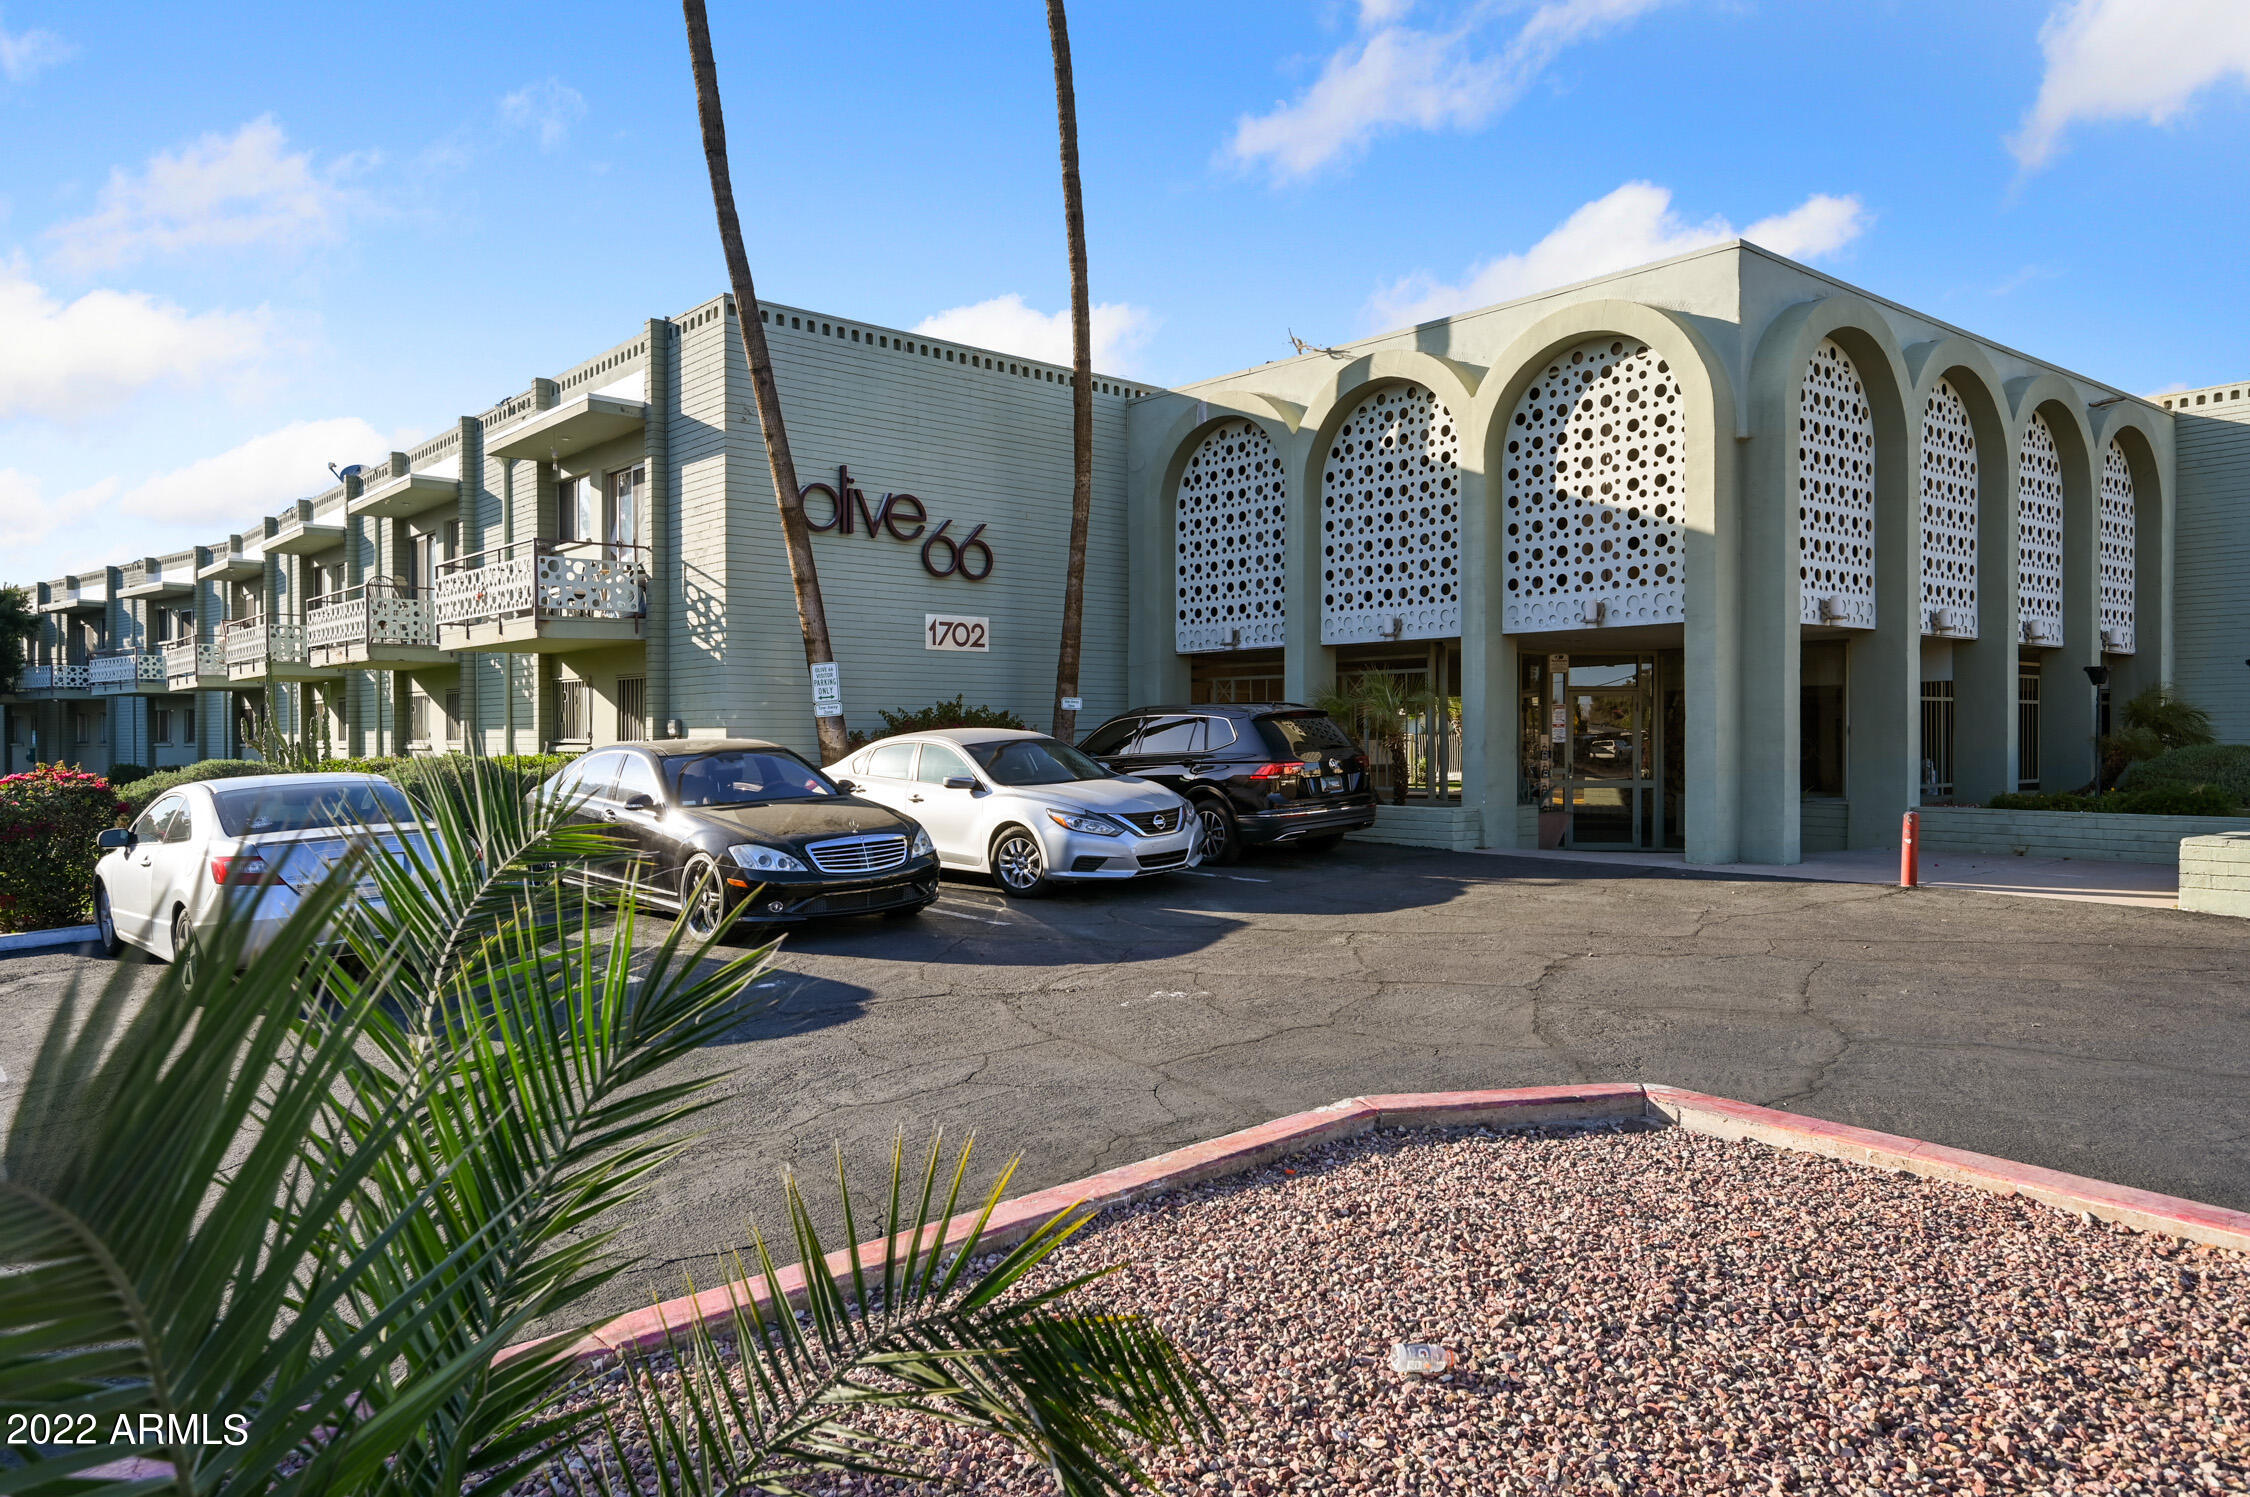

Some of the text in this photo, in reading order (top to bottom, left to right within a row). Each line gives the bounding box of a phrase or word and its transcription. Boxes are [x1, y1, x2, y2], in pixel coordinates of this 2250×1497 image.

[799, 465, 994, 580] olive 66
[928, 618, 986, 648] 1702
[814, 678, 836, 686] PARKING
[818, 687, 833, 695] ONLY
